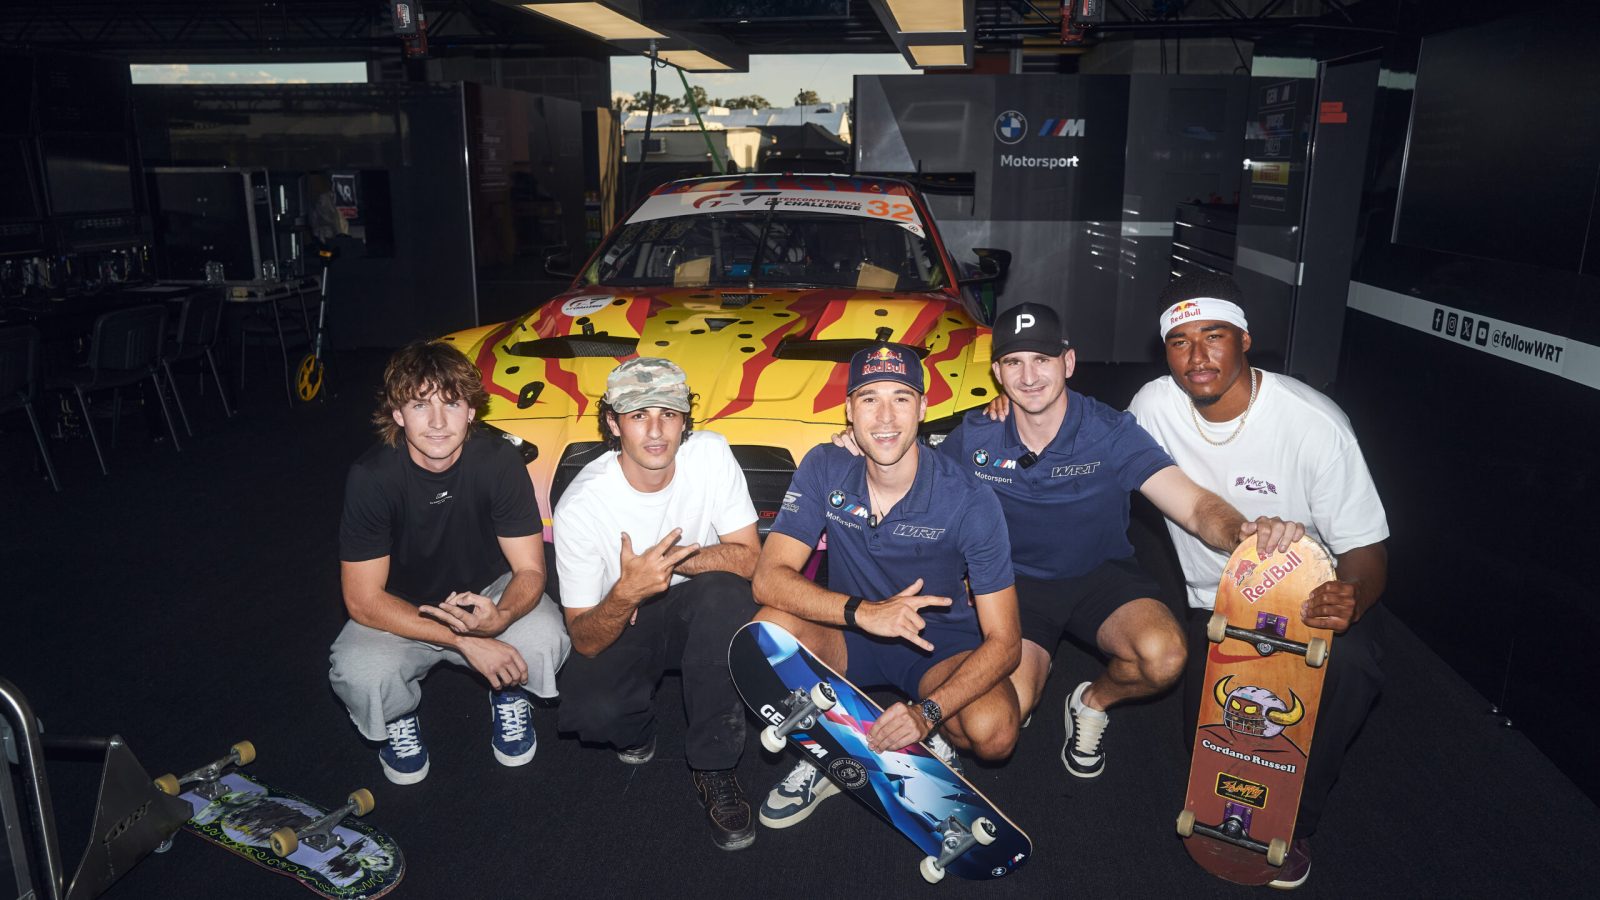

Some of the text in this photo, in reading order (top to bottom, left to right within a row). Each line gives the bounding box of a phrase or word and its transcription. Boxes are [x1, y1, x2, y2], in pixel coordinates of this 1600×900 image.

[1000, 154, 1079, 170] Motorsport
[784, 201, 862, 211] CHALLENGE
[866, 200, 914, 222] 32
[1170, 308, 1201, 325] Red Bull
[1492, 329, 1564, 363] @followWRT
[862, 361, 907, 376] Red Bull
[974, 470, 1013, 484] Motorsport
[1051, 461, 1101, 478] WRT
[892, 523, 946, 541] WRT
[1242, 550, 1302, 603] Red Bull
[760, 703, 788, 728] GE
[1202, 739, 1296, 774] Cordano Russell
